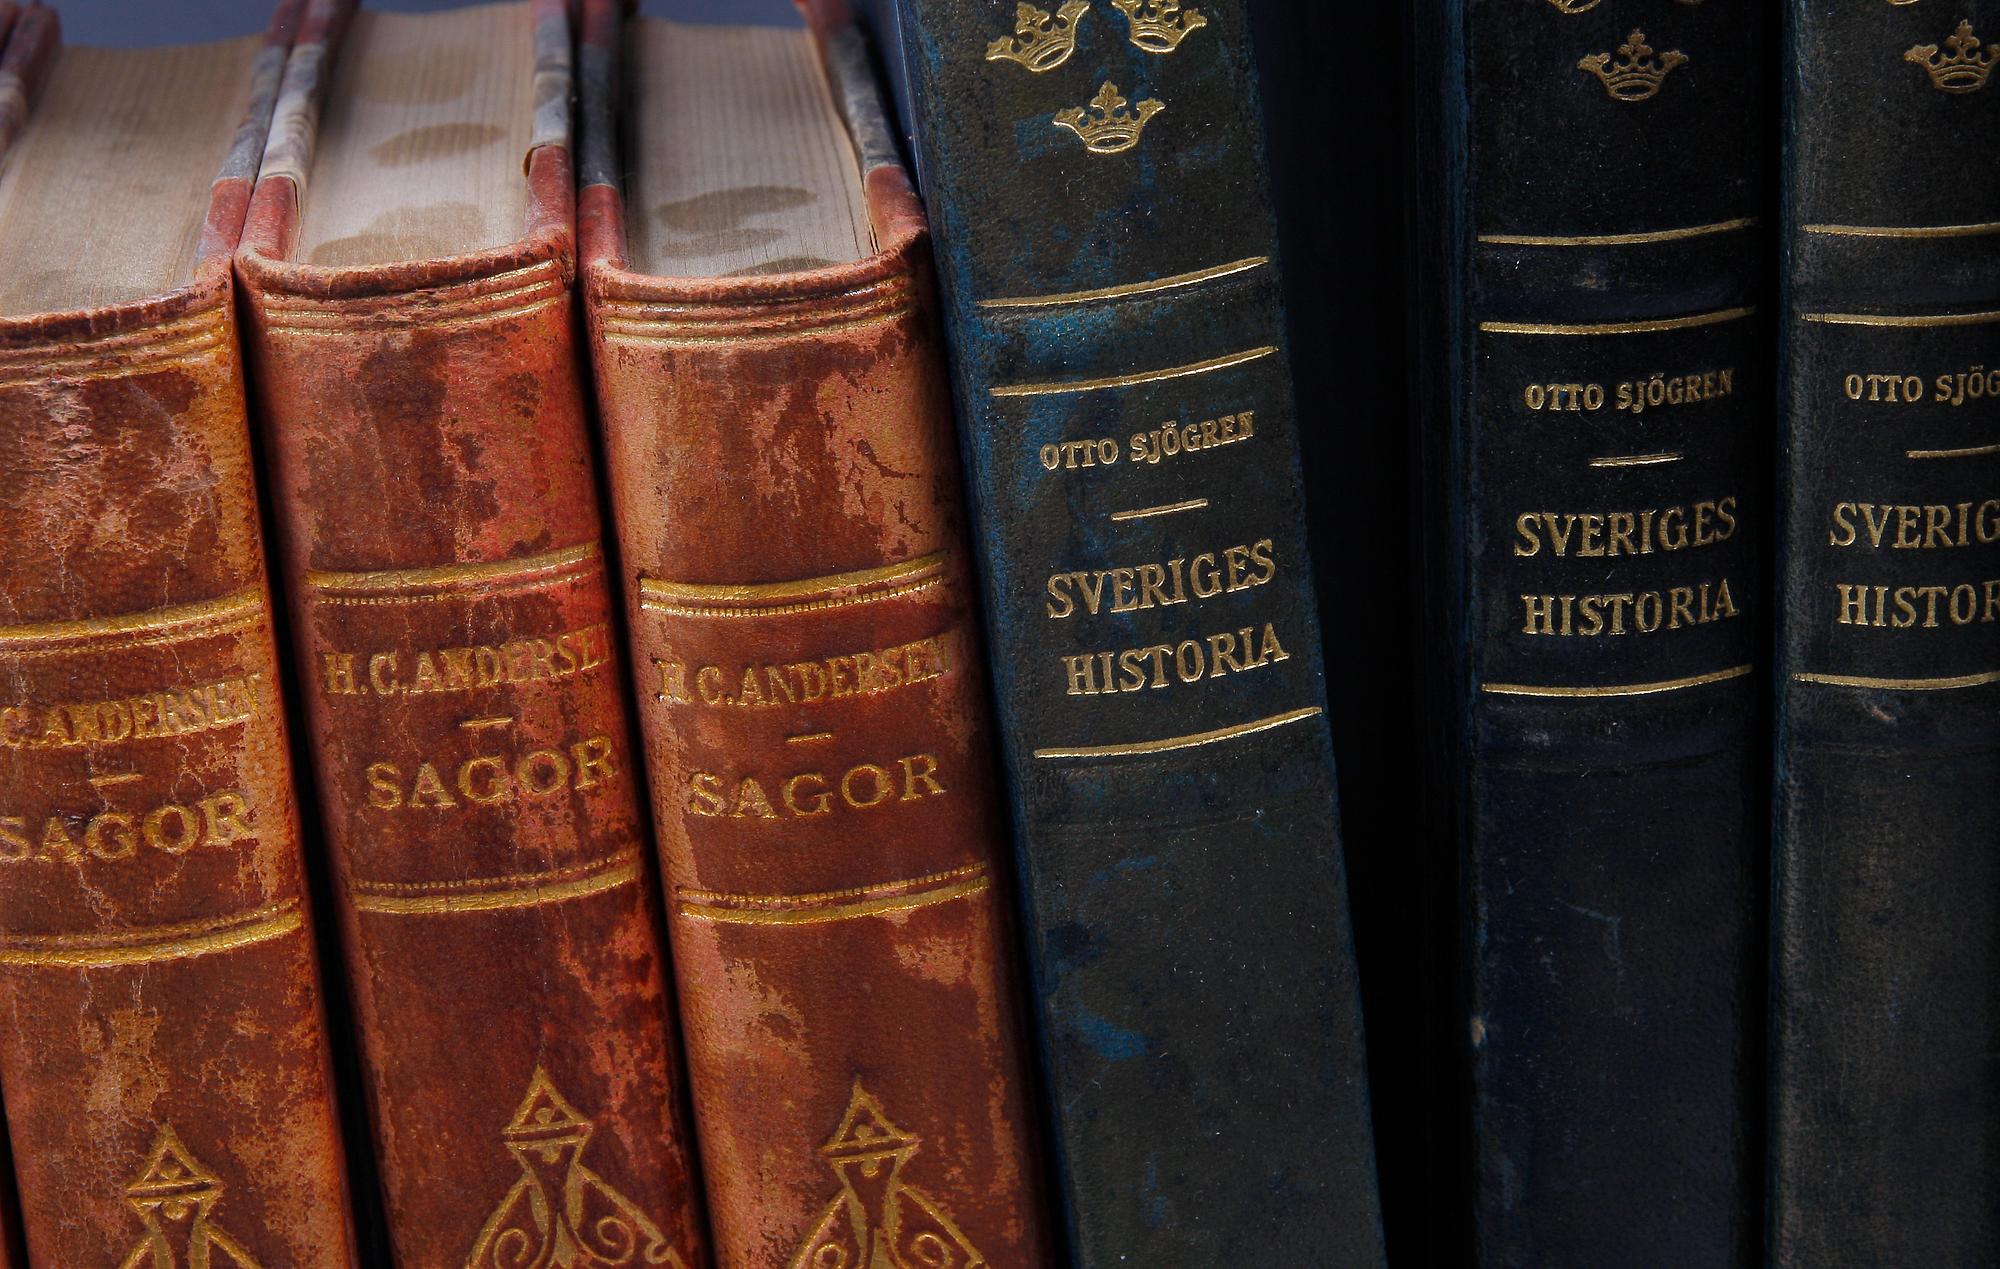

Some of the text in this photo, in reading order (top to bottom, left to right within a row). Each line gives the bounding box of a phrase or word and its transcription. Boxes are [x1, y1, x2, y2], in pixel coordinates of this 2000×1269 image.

[1524, 368, 1735, 414] OTTO SJÖGREN
[1845, 373, 1924, 402] OTTO
[1040, 410, 1254, 471] OTTO SJÖGREN
[1513, 496, 1737, 557] SVERIGES
[1046, 538, 1276, 619] SVERIGES
[1520, 576, 1740, 636] HISTORIA
[1061, 622, 1290, 695] HISTORIA
[365, 735, 617, 811] SAGOR
[687, 752, 947, 820] SAGOR
[0, 790, 253, 862] SAGOR
